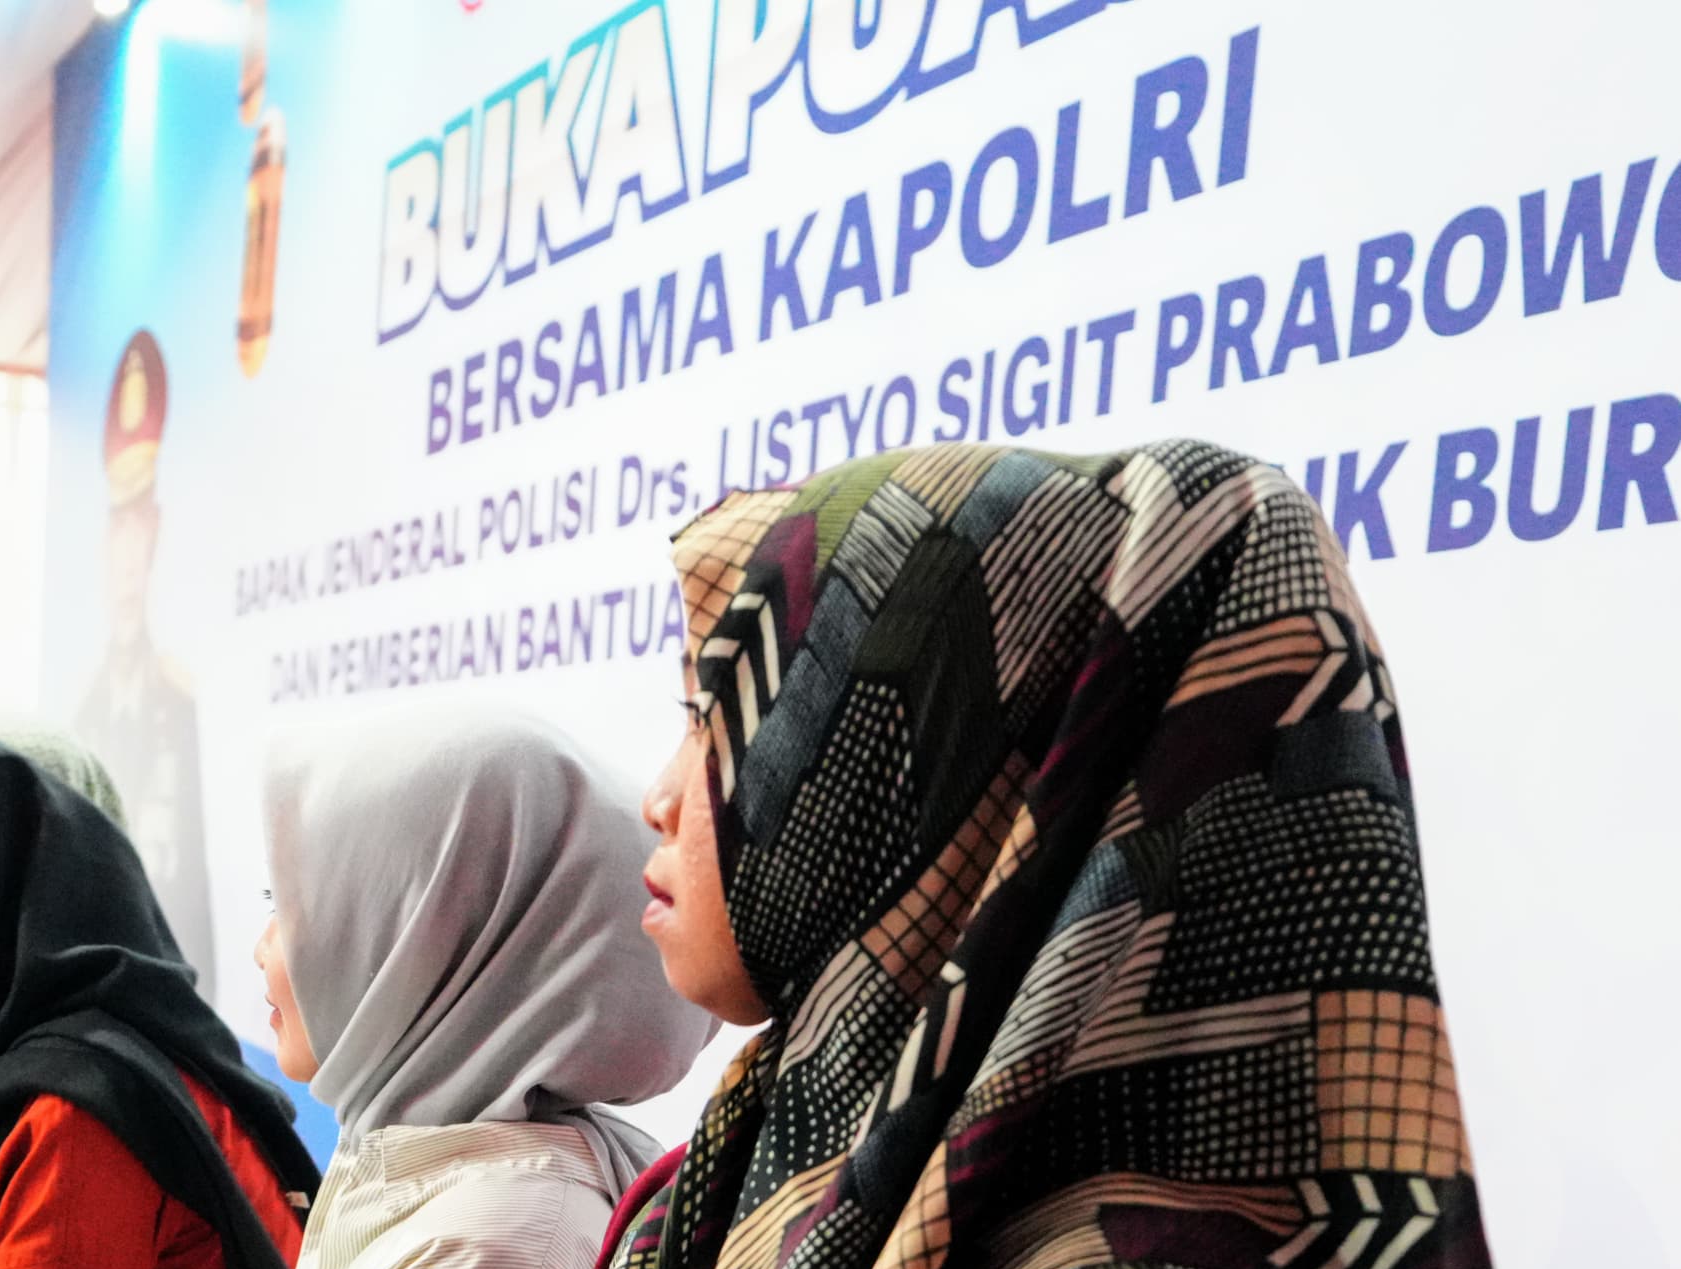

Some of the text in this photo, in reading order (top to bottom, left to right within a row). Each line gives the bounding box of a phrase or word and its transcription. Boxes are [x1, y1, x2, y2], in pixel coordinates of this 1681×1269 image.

[378, 0, 690, 346] BUKA
[426, 26, 1261, 456] BERSAMA KAPOLRI
[270, 651, 319, 703] DAN
[328, 613, 505, 695] PEMBERIAN
[1426, 393, 1681, 554] BUR
[318, 506, 465, 597] JENDERAL
[478, 466, 597, 562] POLISI
[720, 375, 916, 500] LISTYO
[934, 309, 1136, 442] SIGIT
